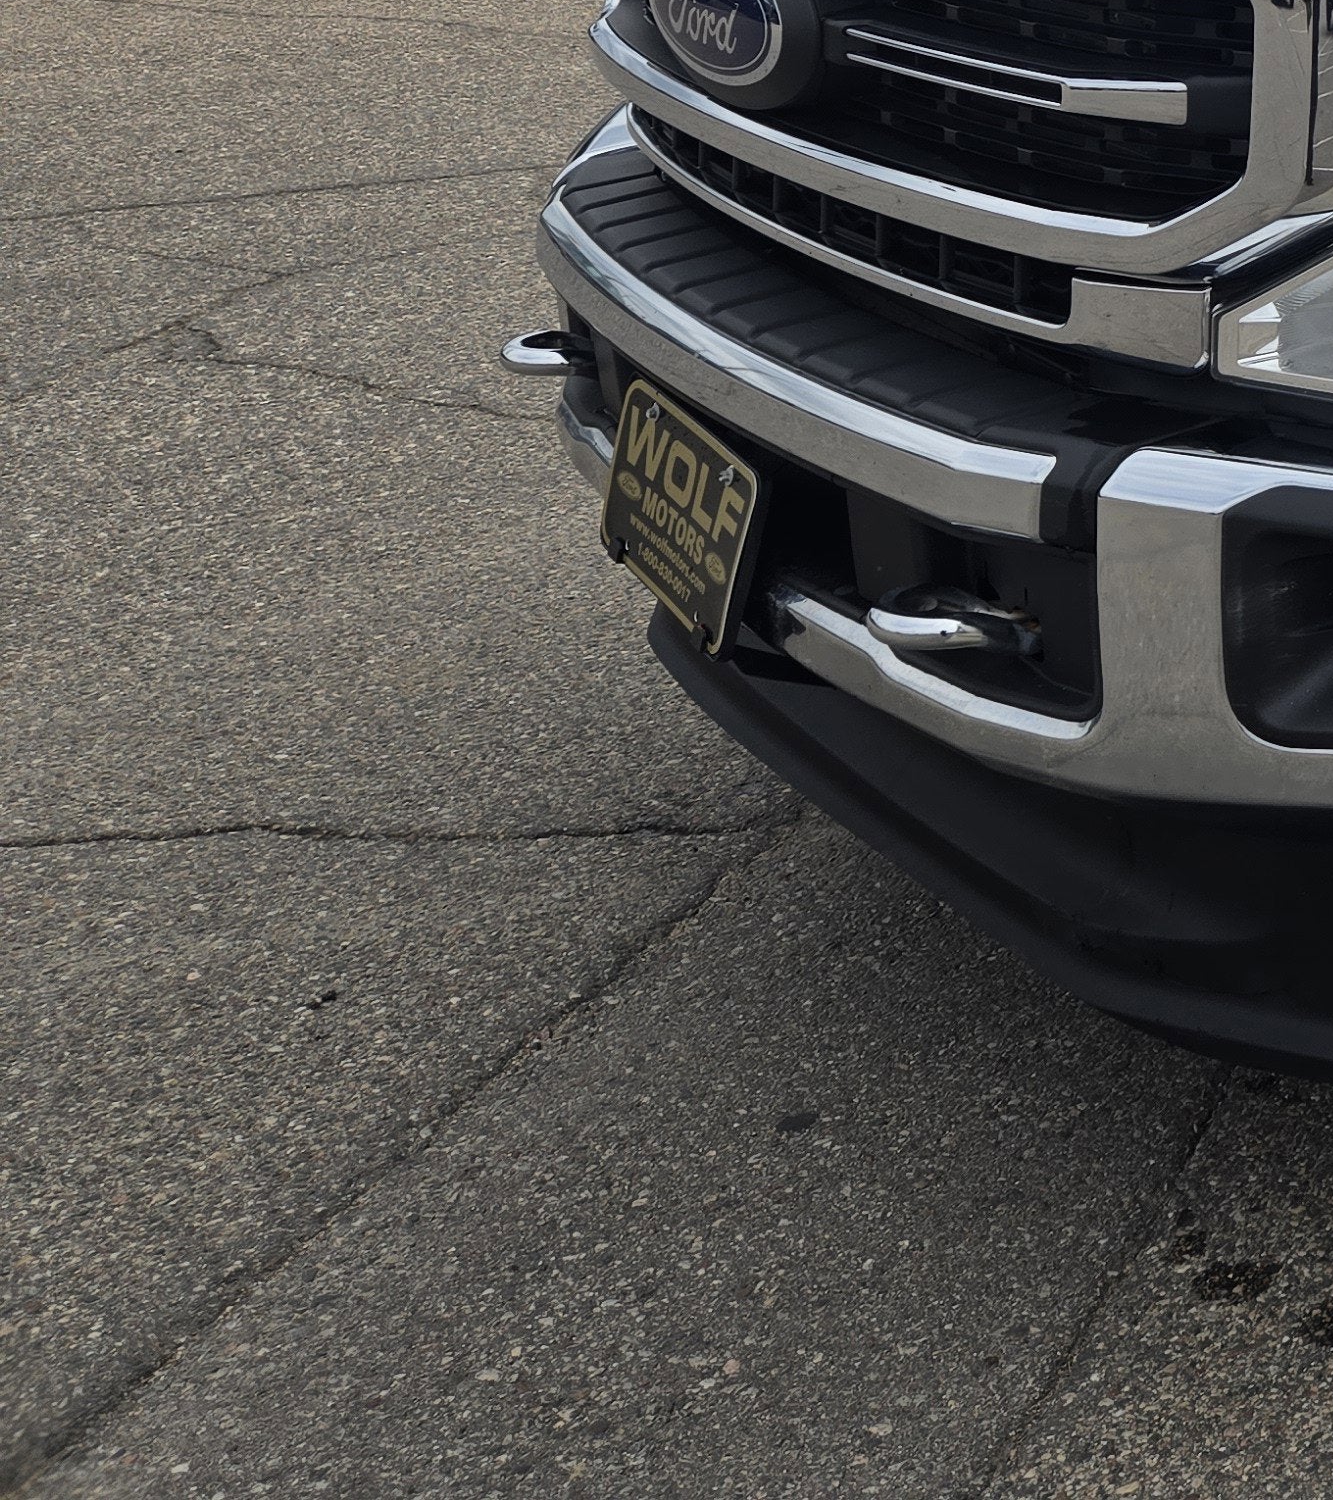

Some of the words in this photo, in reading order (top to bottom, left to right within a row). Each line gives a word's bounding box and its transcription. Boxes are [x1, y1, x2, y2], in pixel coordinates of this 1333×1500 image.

[626, 405, 746, 543] WOLF
[630, 513, 706, 595] www.wolfmotors.com
[641, 486, 706, 566] MOTORS
[637, 542, 691, 602] 1-800-830-0017
